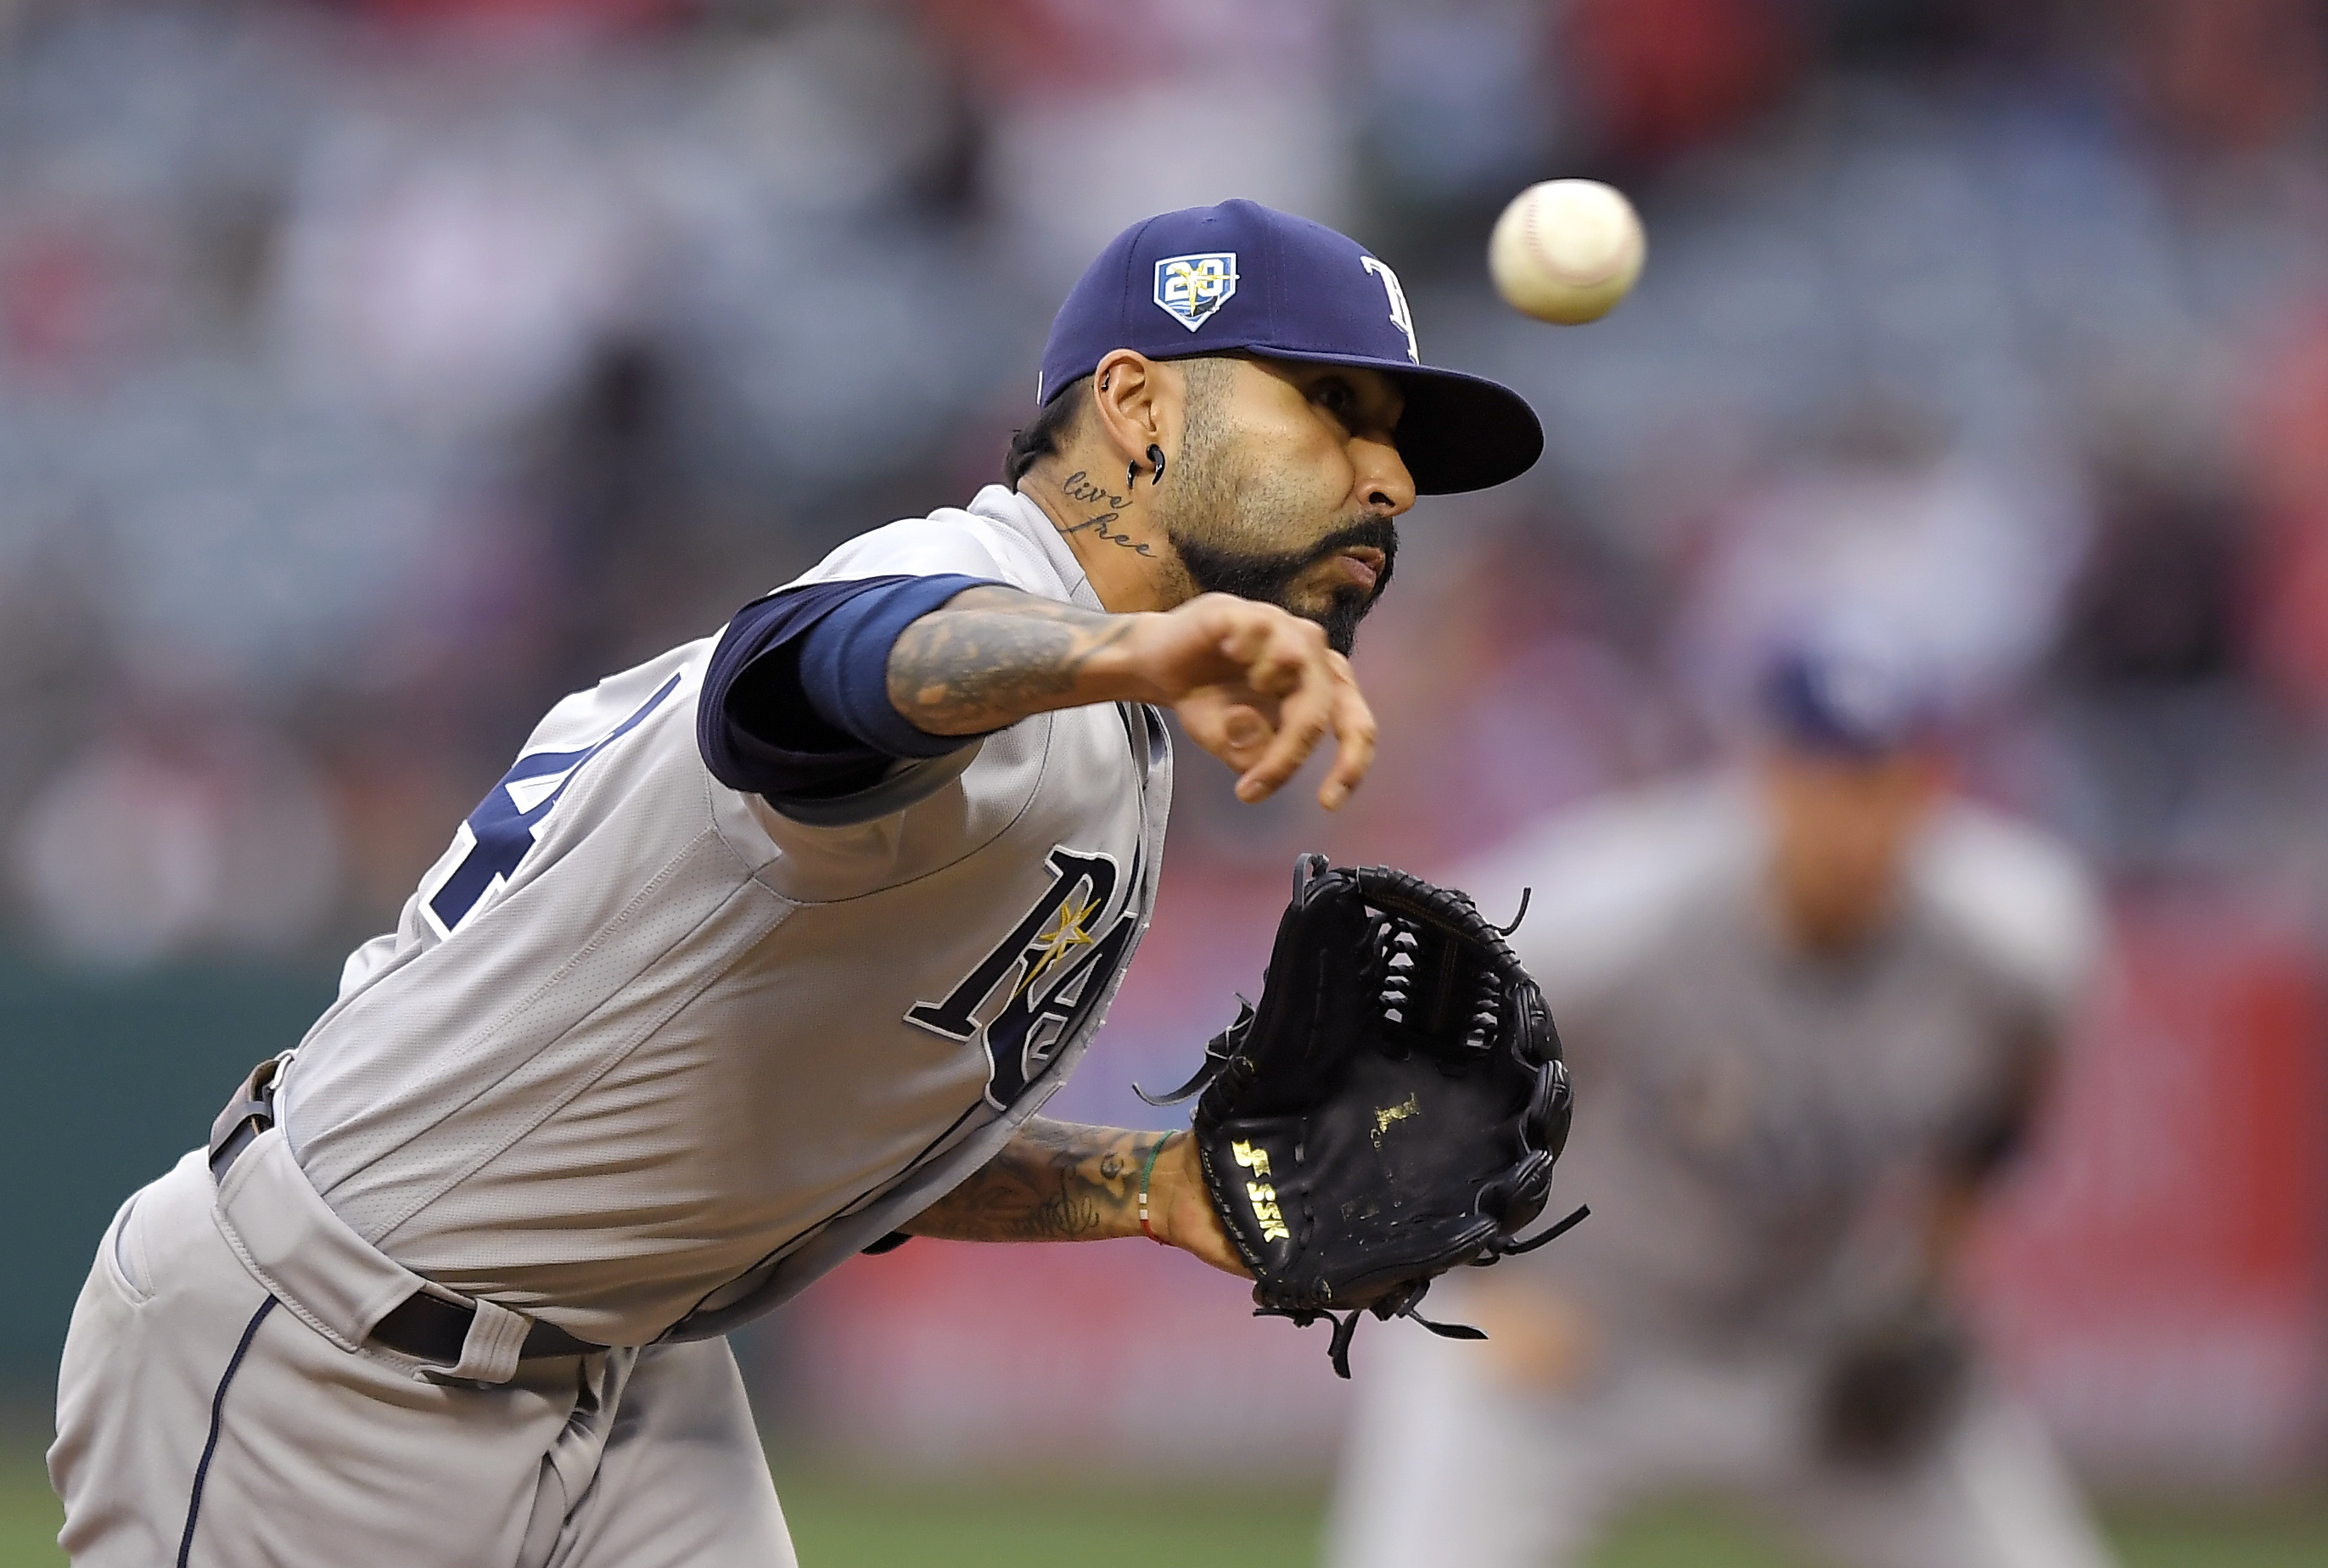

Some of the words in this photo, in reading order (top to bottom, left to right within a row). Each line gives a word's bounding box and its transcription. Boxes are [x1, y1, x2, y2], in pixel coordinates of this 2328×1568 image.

[1164, 258, 1225, 302] 20
[1063, 471, 1134, 509] live
[1057, 512, 1158, 558] free
[1246, 1180, 1291, 1243] SSK
